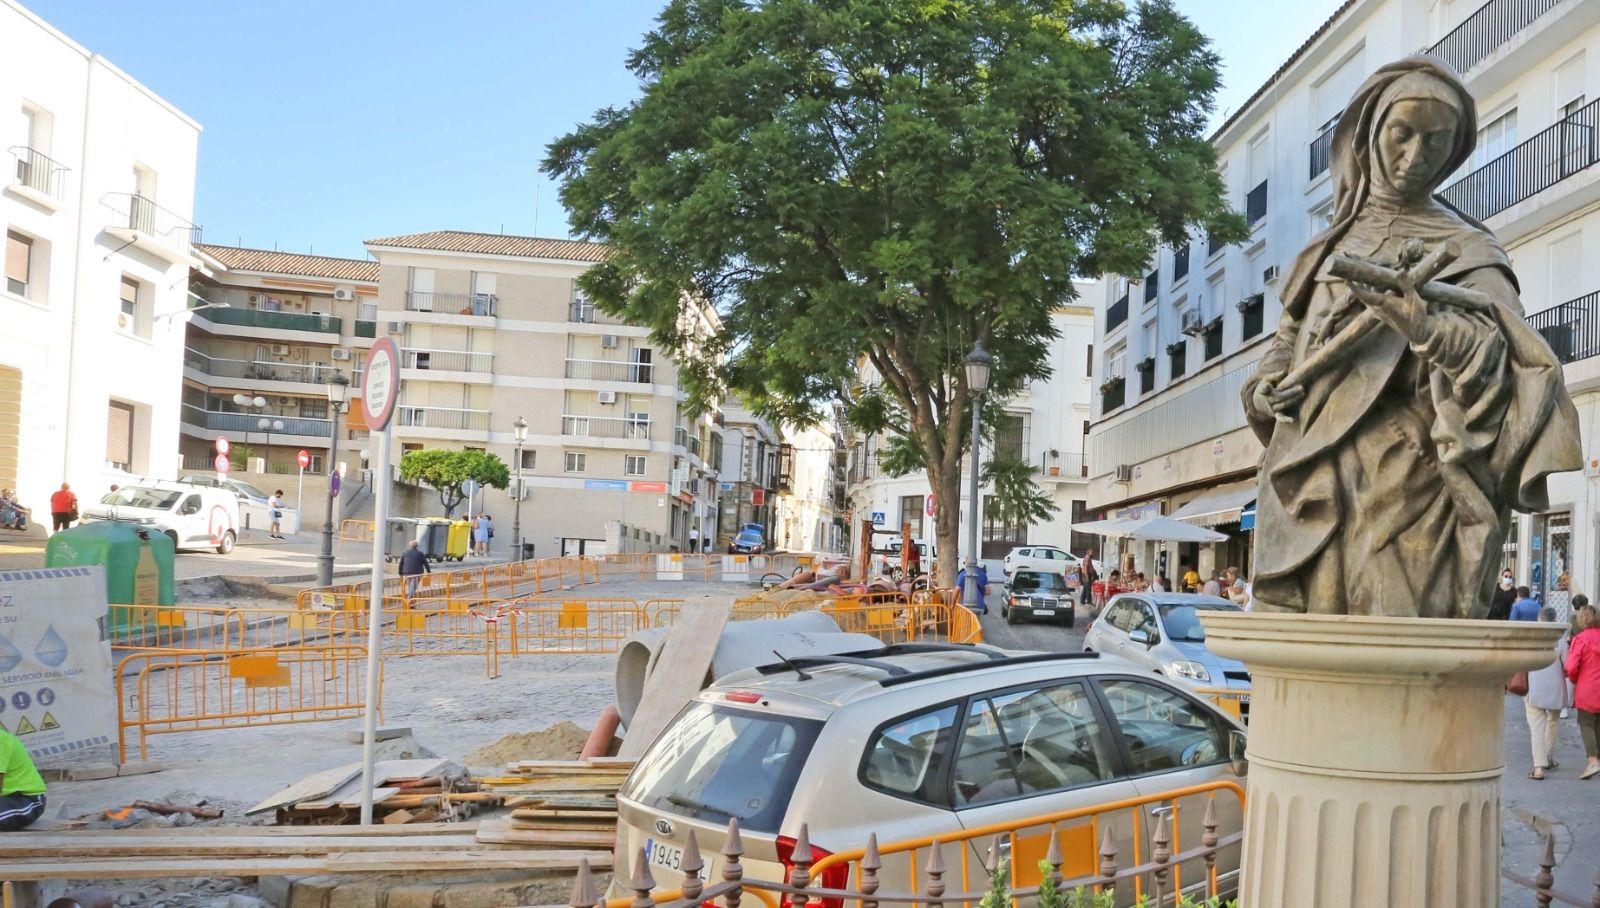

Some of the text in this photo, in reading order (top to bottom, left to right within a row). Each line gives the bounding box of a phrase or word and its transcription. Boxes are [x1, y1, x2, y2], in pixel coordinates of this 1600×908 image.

[0, 595, 16, 608] Z
[2, 672, 42, 683] SERVICIO
[652, 843, 681, 870] 1945
